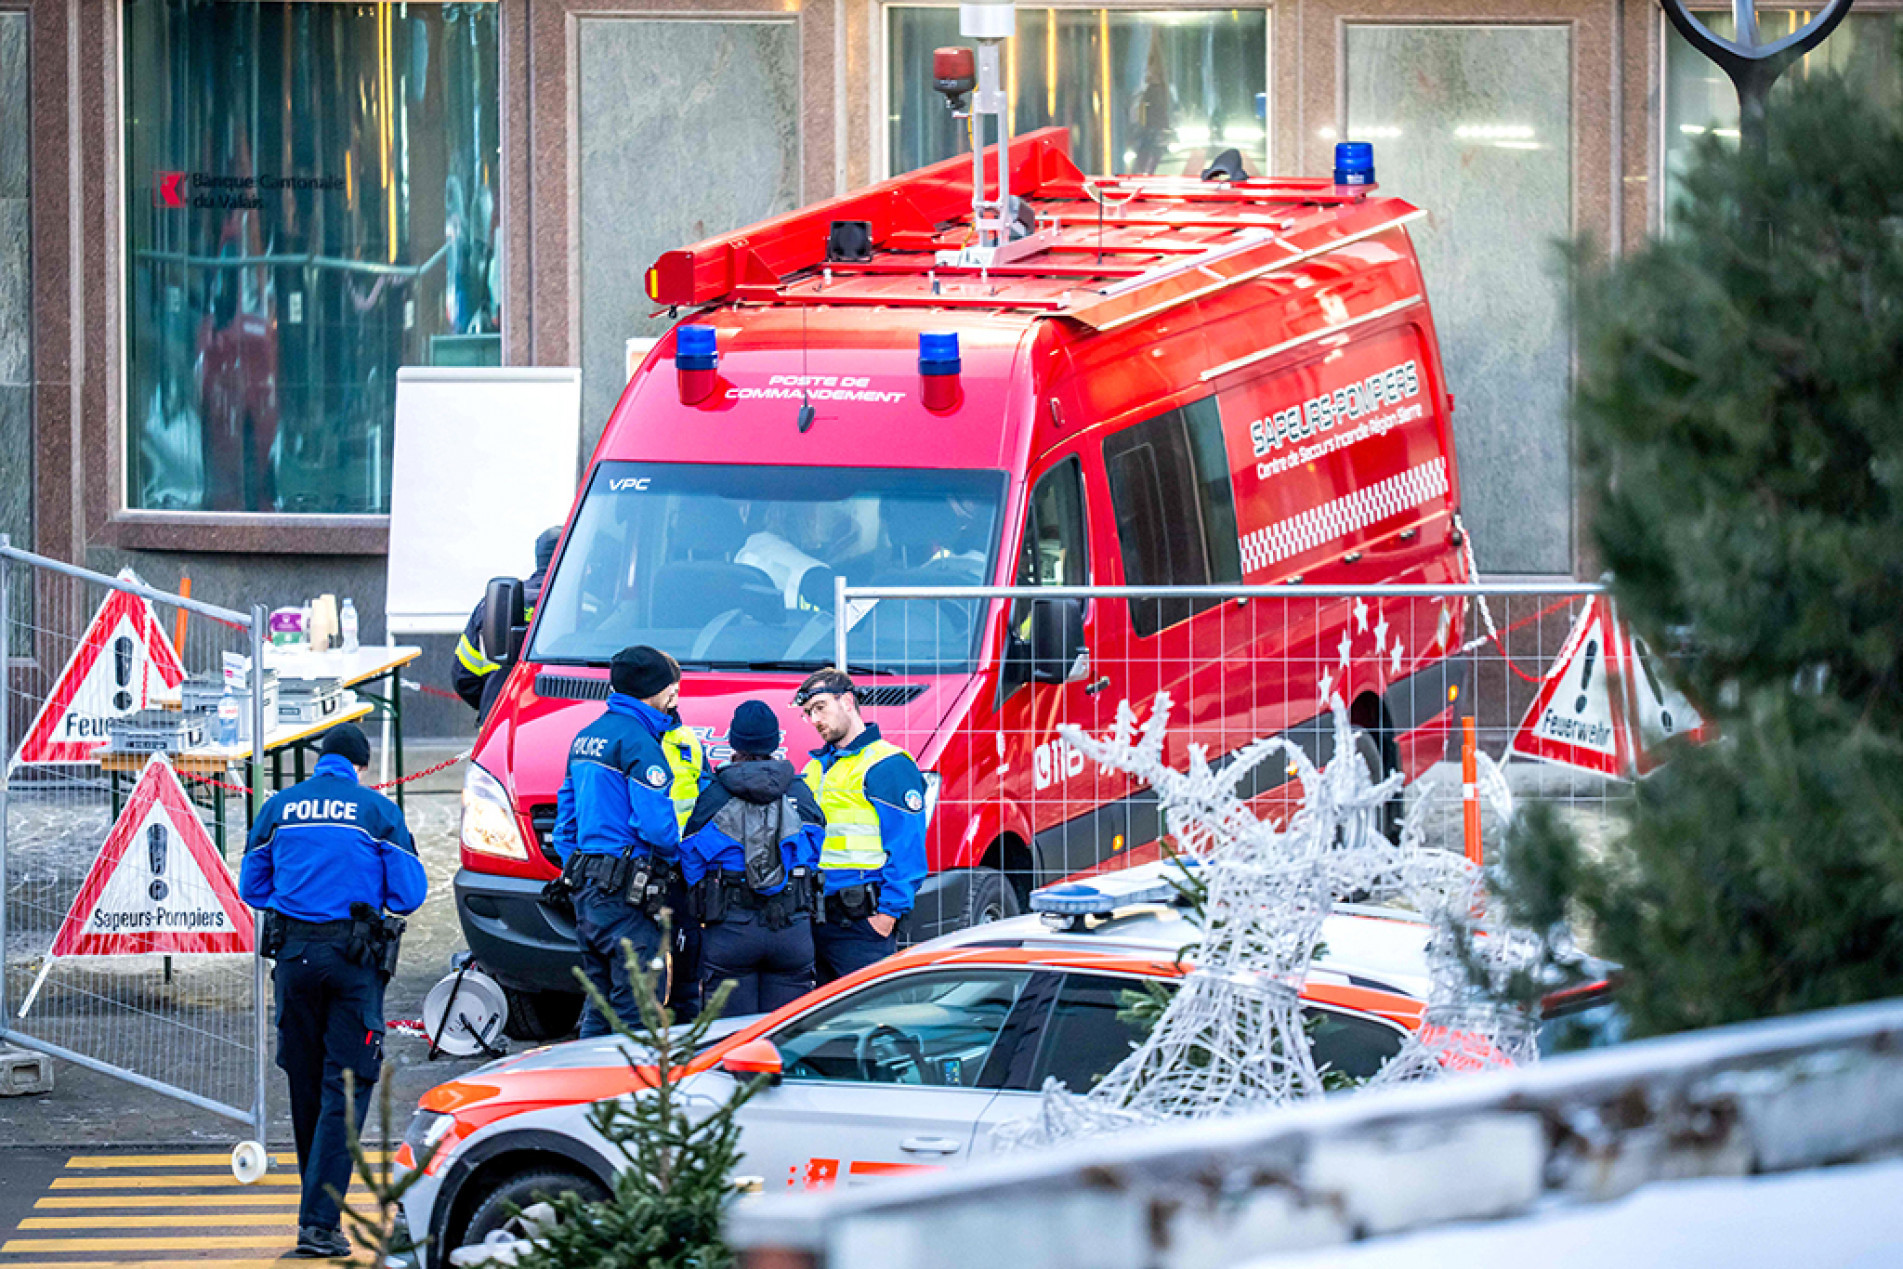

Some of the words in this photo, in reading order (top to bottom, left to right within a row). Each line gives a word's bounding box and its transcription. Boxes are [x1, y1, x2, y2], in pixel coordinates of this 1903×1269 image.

[193, 173, 254, 189] Banque
[260, 174, 345, 190] Cantonale
[194, 195, 214, 209] du
[219, 195, 264, 209] Valais
[769, 375, 837, 387] POSTE
[840, 376, 871, 388] DE
[725, 388, 906, 403] COMMANDEMENT
[1250, 360, 1419, 457] SAPEURS-POMPIERS
[1257, 456, 1287, 480] Centre
[1287, 450, 1299, 468] de
[1299, 438, 1335, 463] Secours
[609, 477, 652, 491] VPC
[1543, 707, 1611, 746] Feuerwehr
[282, 799, 358, 820] POLICE
[94, 907, 224, 931] Sapeurs-Pompiers
